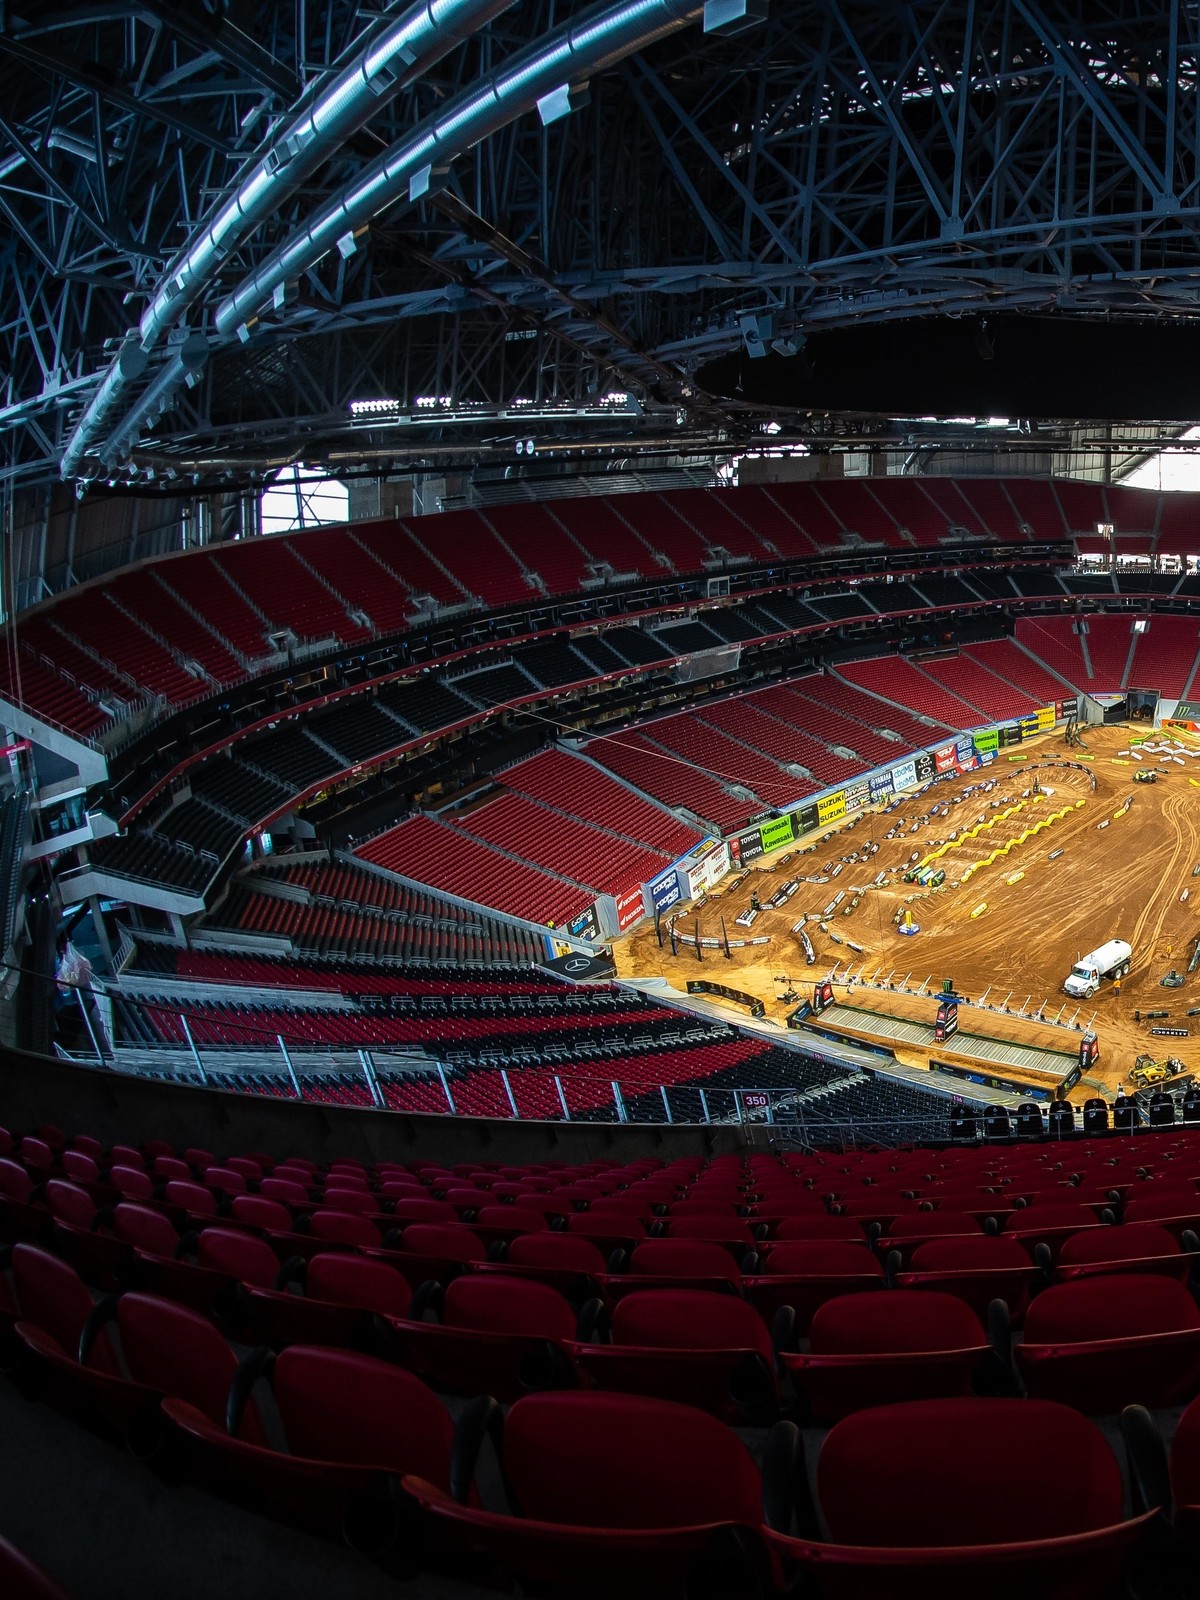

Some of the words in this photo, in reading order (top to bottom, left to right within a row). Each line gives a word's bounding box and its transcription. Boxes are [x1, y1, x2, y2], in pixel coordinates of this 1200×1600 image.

[819, 794, 844, 811] SUZUKI
[820, 807, 845, 824] SUZUKI
[762, 819, 790, 837] Kawasaki
[740, 832, 760, 845] TOYOTA
[764, 832, 793, 849] Kawasaki
[742, 846, 763, 859] TOYOTA
[653, 872, 677, 895] COOPER
[655, 887, 679, 910] COOPER
[571, 909, 592, 928] GoPro
[579, 924, 595, 940] oPro
[745, 1096, 767, 1106] 350
